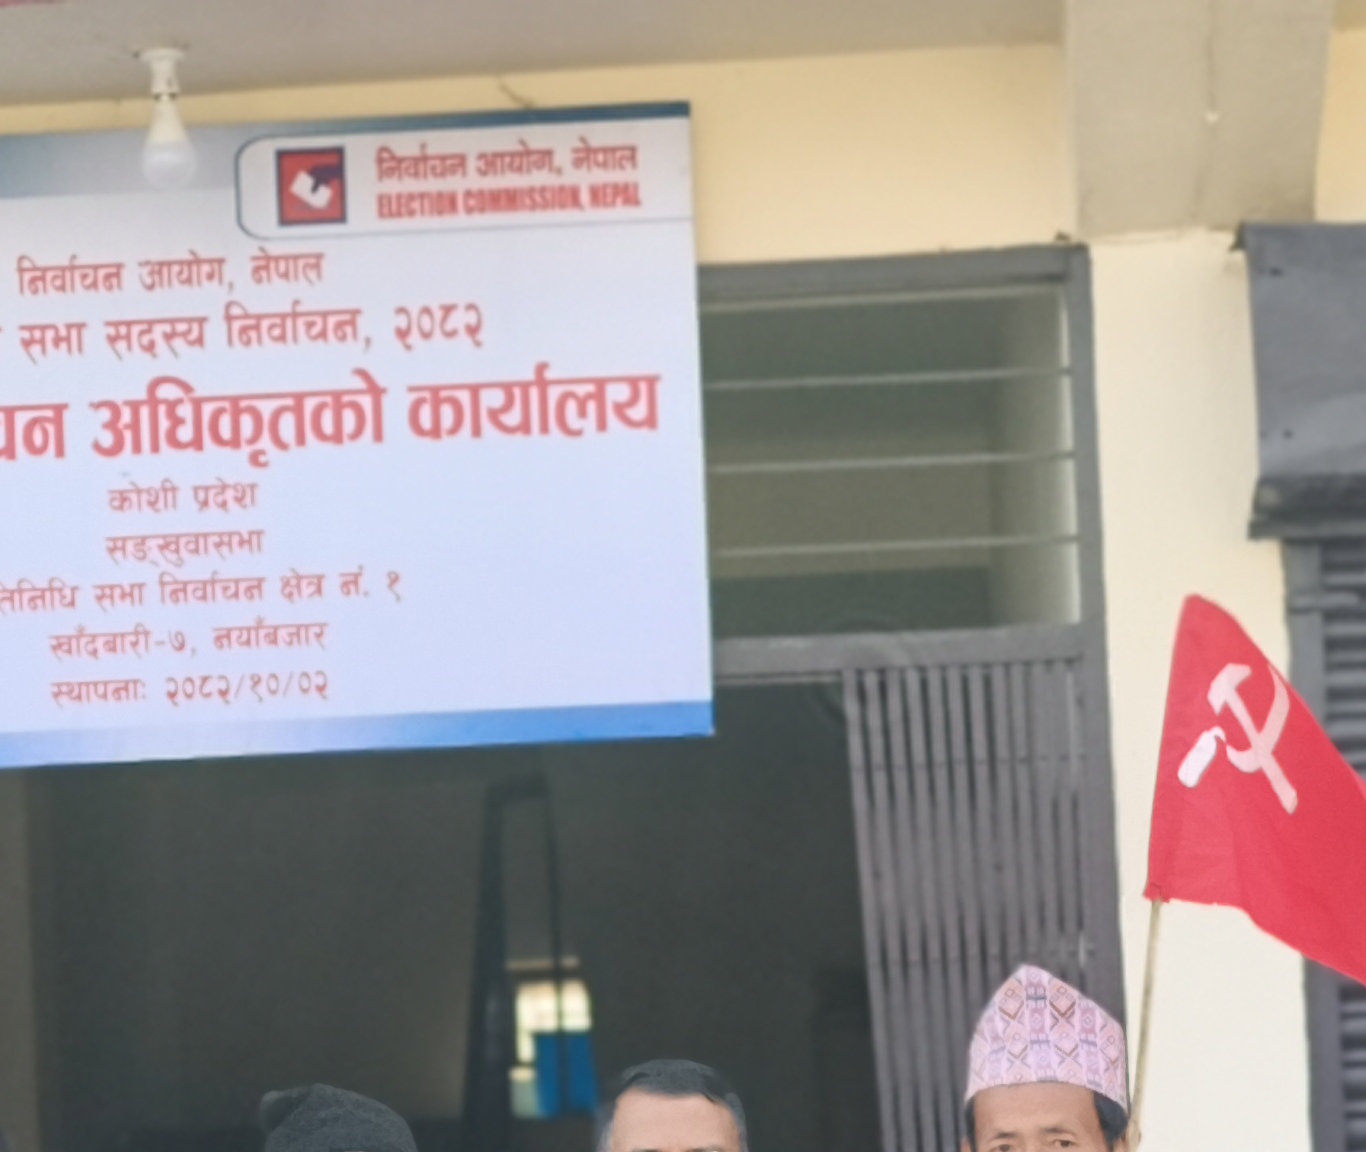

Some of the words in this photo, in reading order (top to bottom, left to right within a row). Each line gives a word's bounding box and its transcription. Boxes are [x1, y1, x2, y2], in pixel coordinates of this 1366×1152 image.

[374, 142, 468, 182] निर्वाचन
[571, 135, 638, 172] नेपाल
[376, 190, 459, 219] ELECTION
[588, 182, 641, 208] NEPAL
[15, 253, 126, 296] निर्वाचन
[249, 245, 326, 285] नेपाल
[17, 321, 88, 364] सभा
[103, 315, 210, 360] सदस्य
[222, 298, 372, 349] निर्वाचन,
[394, 302, 484, 352] २०८२
[88, 367, 388, 469] अधिकृतको
[406, 361, 661, 441] कार्यालय
[107, 477, 180, 514] कोशी
[191, 477, 259, 513] प्रदेश
[92, 581, 147, 612] सभा
[157, 570, 267, 605] निर्वाचन
[280, 568, 327, 603] क्षेत्र
[385, 569, 403, 603] १
